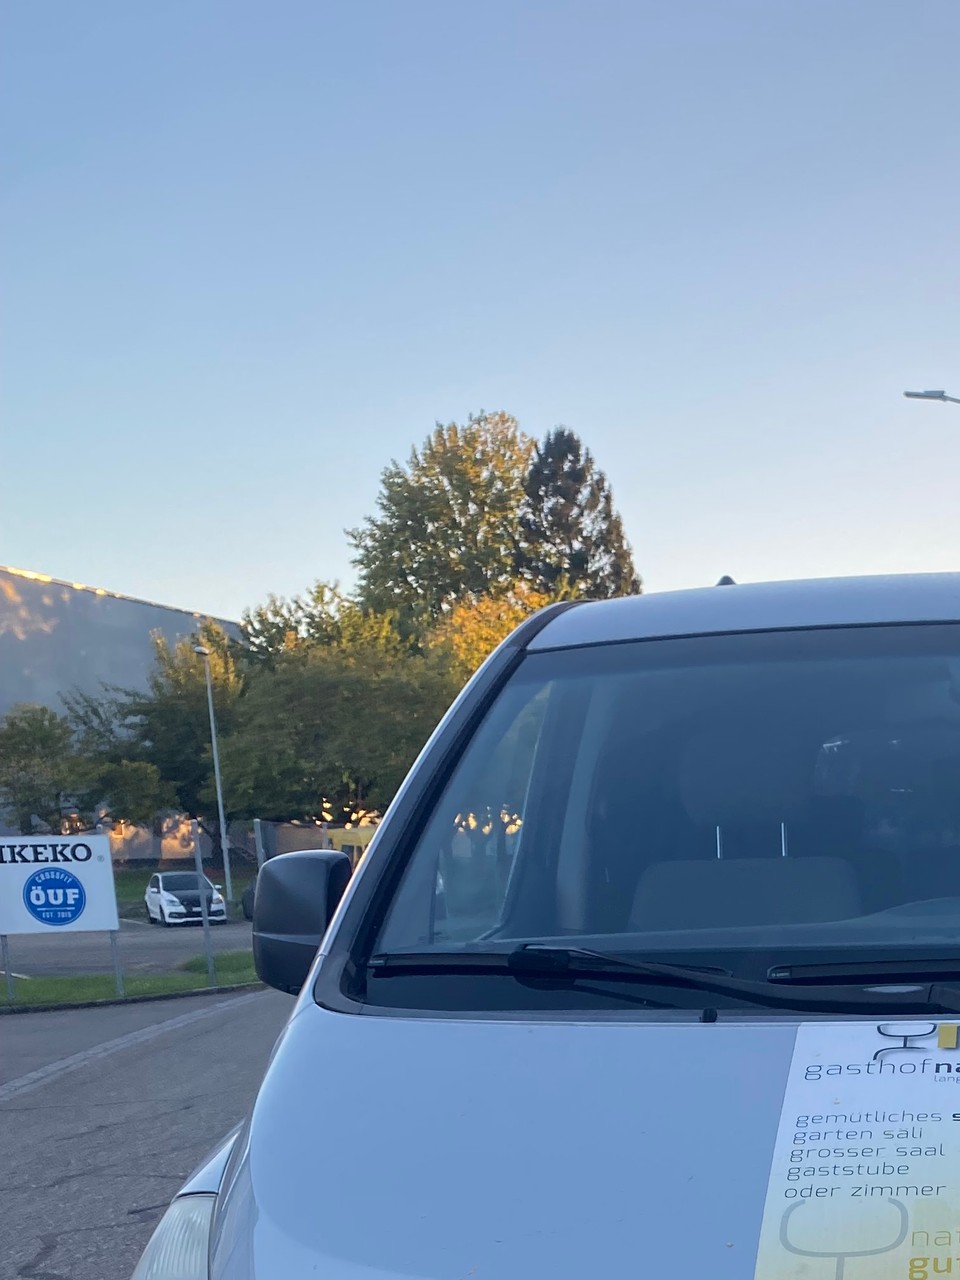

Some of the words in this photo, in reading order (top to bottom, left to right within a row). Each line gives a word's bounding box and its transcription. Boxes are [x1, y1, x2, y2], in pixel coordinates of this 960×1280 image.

[30, 885, 79, 906] ÖUF
[793, 1128, 873, 1145] garten
[789, 1146, 887, 1163] grosser
[896, 1143, 946, 1157] saal
[786, 1162, 910, 1181] gaststube
[784, 1184, 841, 1198] oder
[851, 1184, 947, 1197] zimmer
